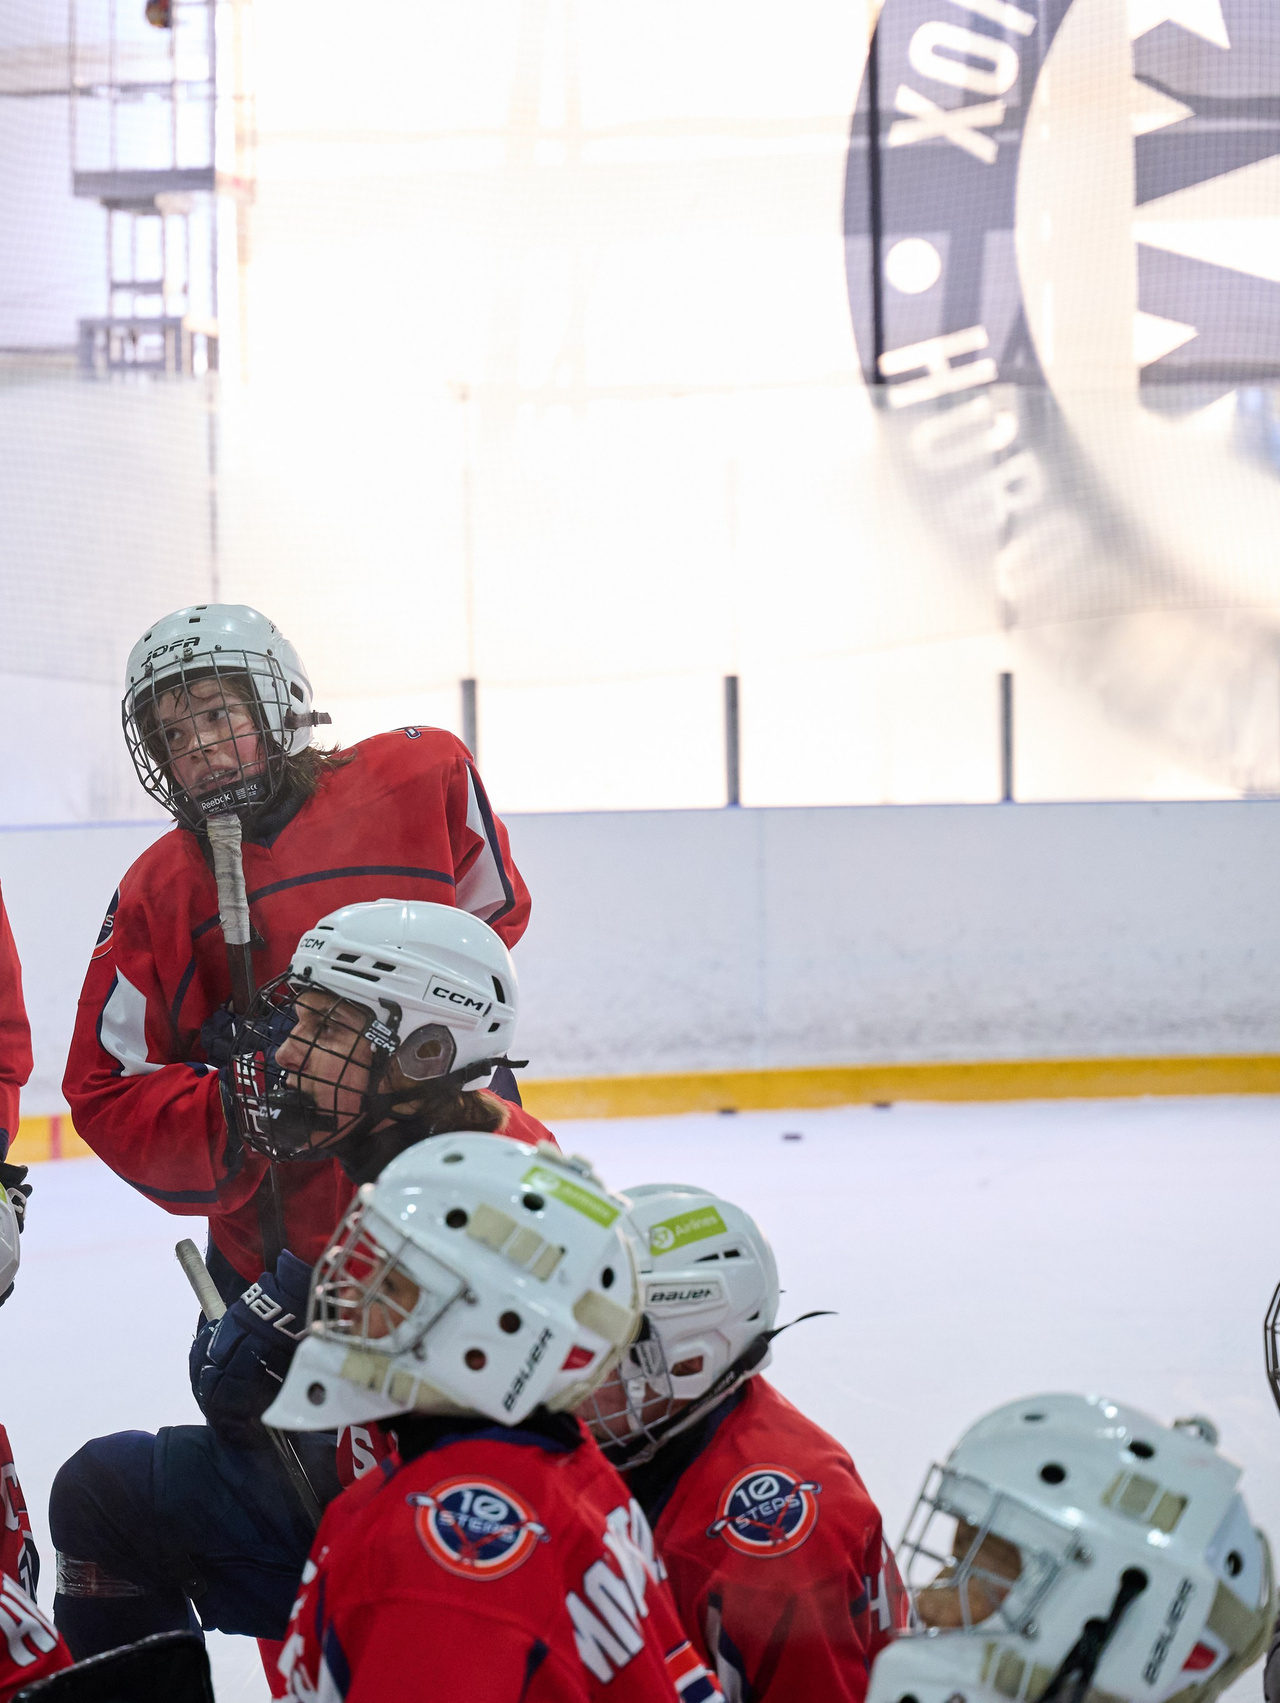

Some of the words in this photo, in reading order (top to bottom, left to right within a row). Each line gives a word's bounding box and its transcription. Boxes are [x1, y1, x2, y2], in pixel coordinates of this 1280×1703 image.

[299, 938, 326, 950] CCM
[432, 987, 486, 1012] CCM
[240, 1282, 312, 1341] BAU
[460, 1489, 509, 1522] 10
[735, 1475, 780, 1508] 10
[734, 1494, 801, 1530] STEPS
